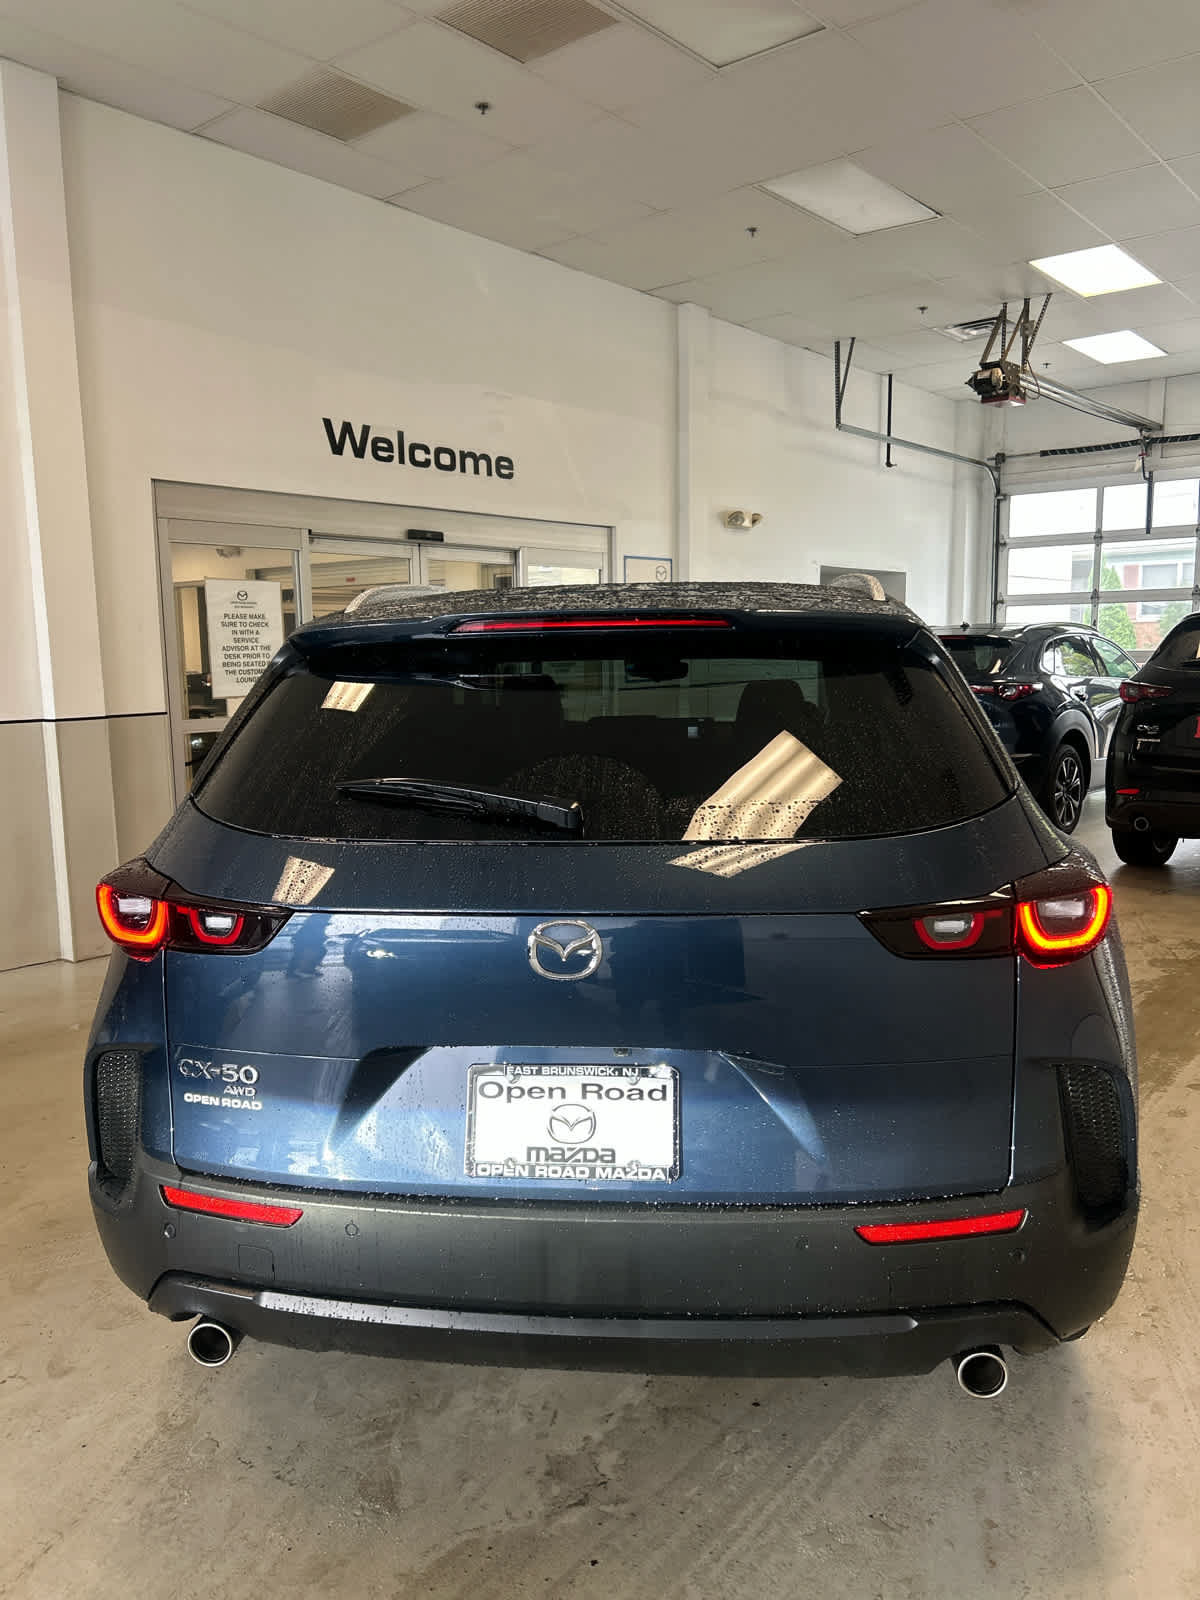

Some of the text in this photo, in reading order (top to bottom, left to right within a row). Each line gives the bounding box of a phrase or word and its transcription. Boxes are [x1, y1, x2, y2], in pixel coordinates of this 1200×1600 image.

[322, 417, 514, 480] Welcome
[179, 1058, 259, 1085] CX-50
[506, 1066, 538, 1076] EAST
[622, 1068, 639, 1077] NJ
[224, 1086, 256, 1096] AWD
[478, 1081, 667, 1104] Open Road
[184, 1092, 262, 1111] OPEN ROAD
[526, 1146, 616, 1164] mazda
[476, 1164, 665, 1180] OPEN ROAD MAZDA
